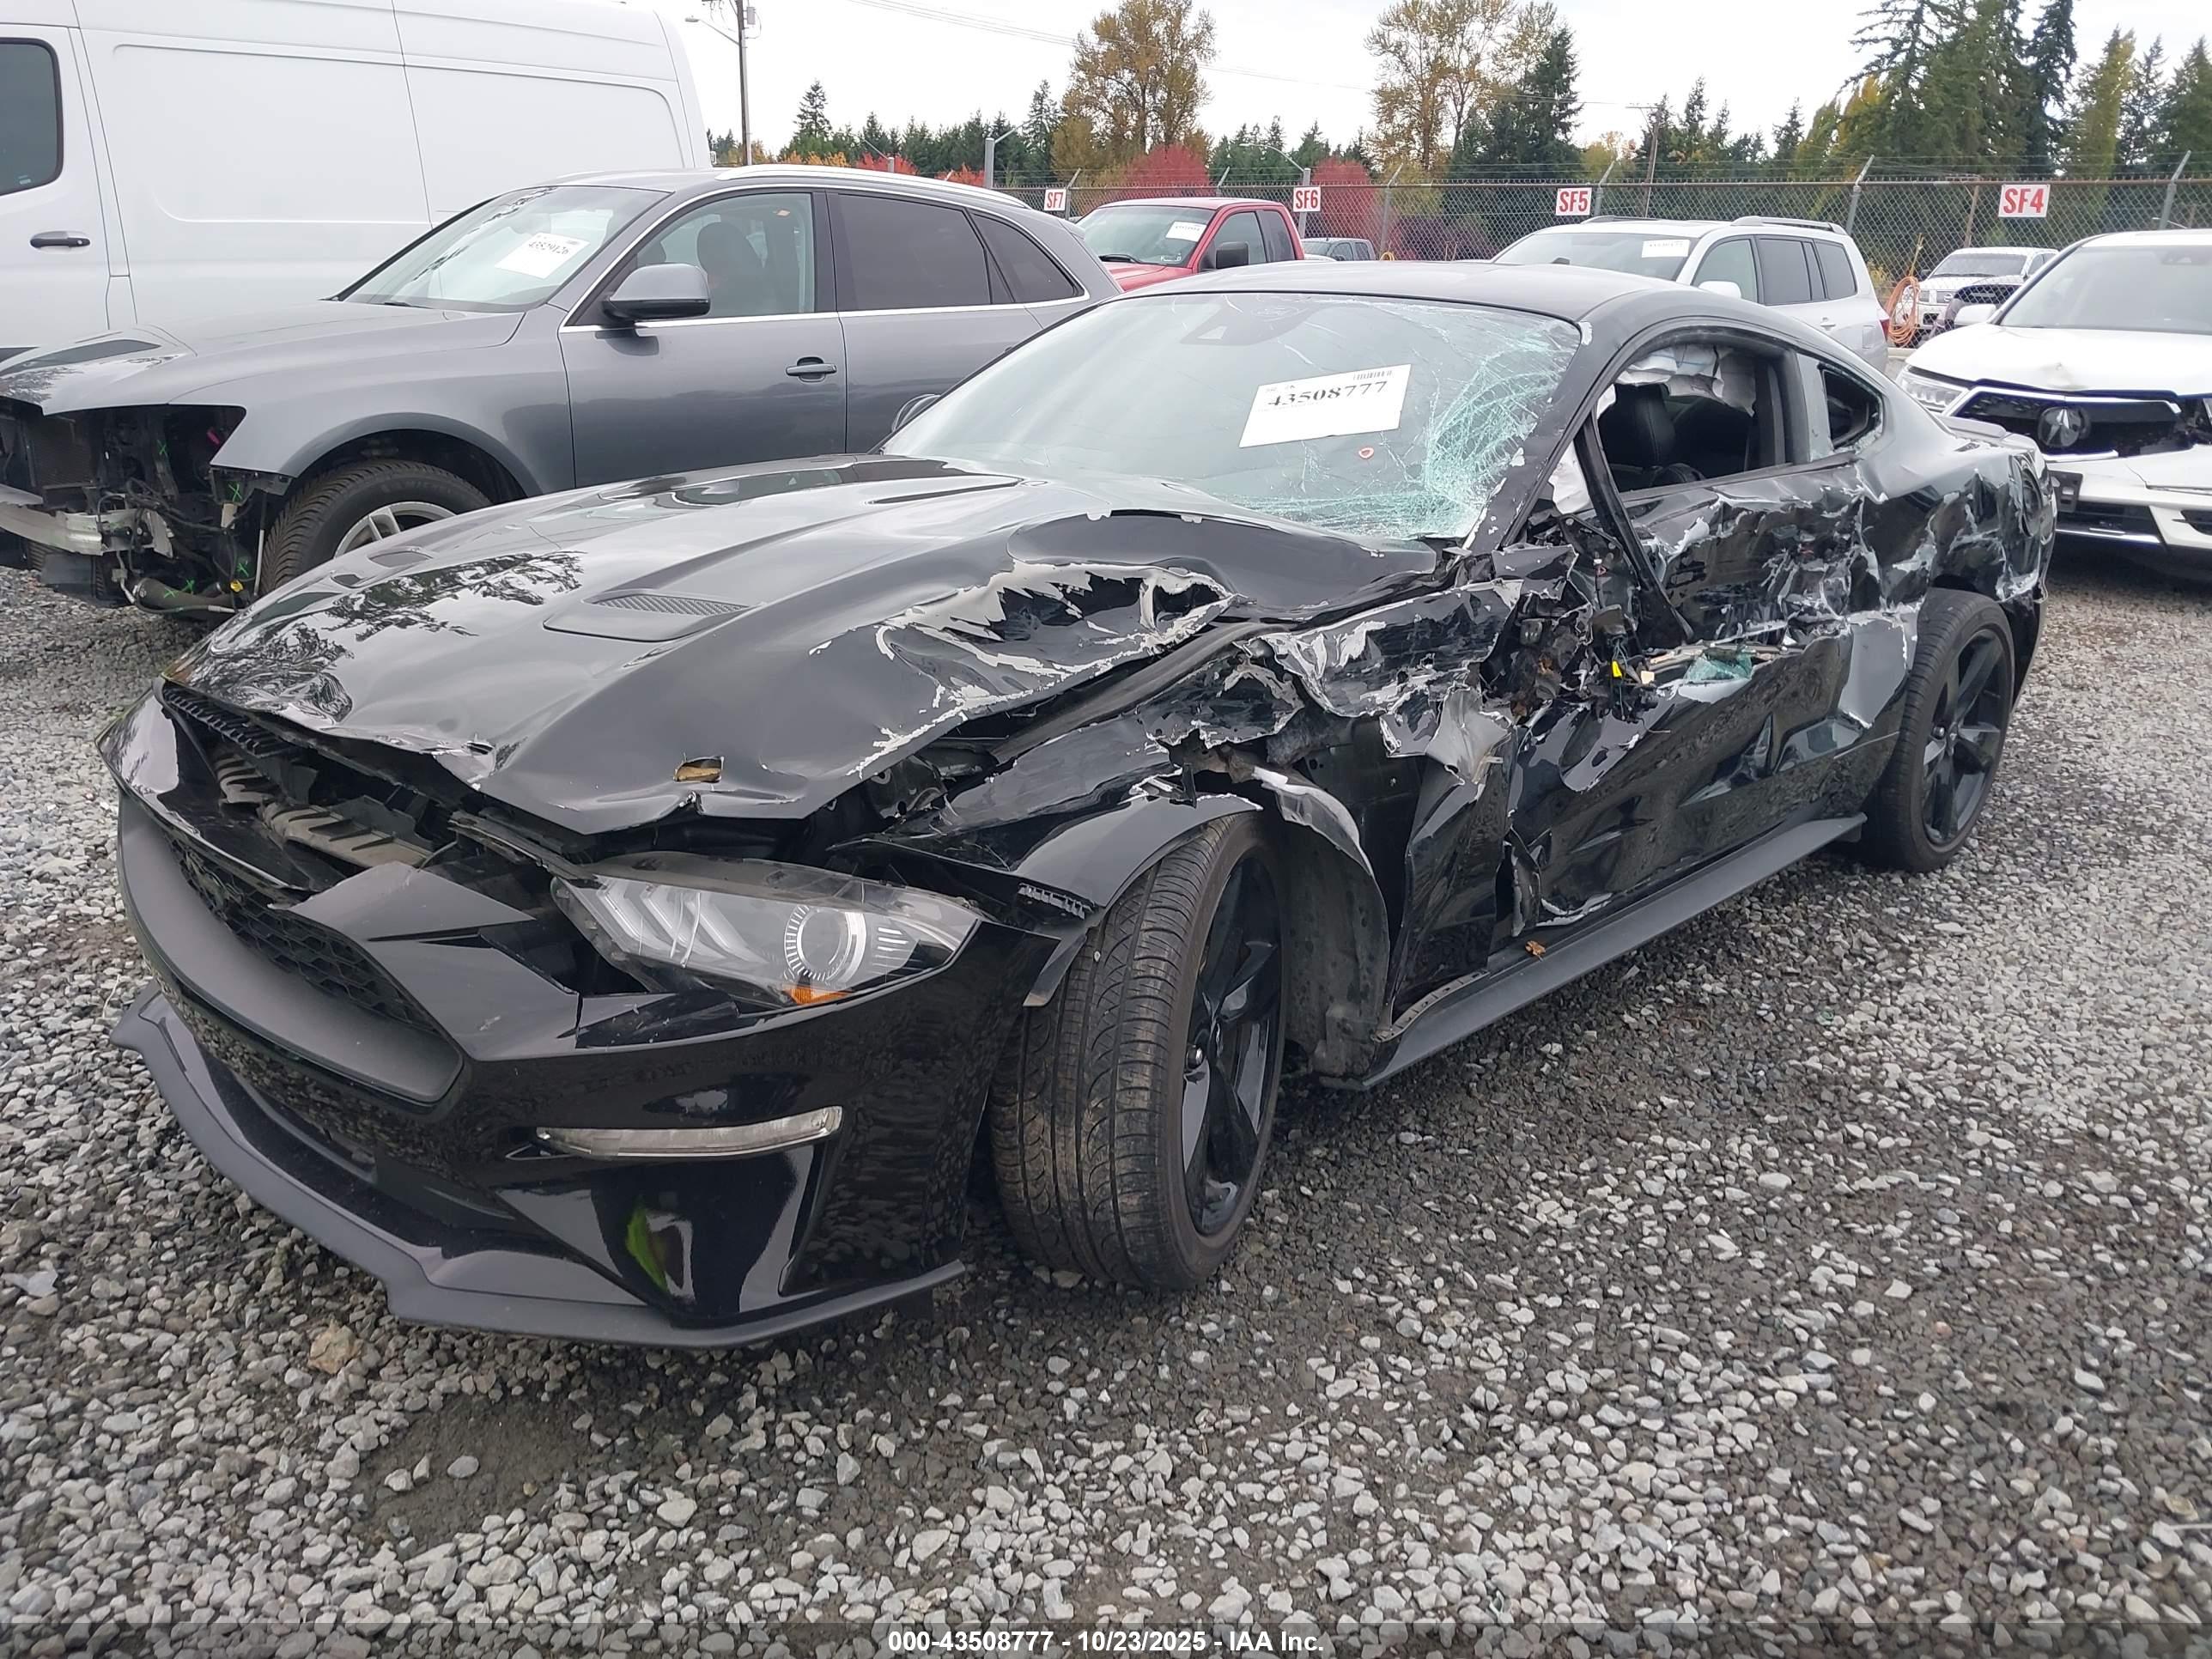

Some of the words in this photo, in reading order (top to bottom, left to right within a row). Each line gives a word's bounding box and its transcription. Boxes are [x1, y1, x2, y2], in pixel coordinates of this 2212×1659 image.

[1047, 191, 1064, 209] SF7
[1295, 189, 1319, 210] SF6
[1559, 190, 1589, 212] SF5
[2002, 187, 2045, 214] SF4
[1268, 380, 1388, 406] 43508777
